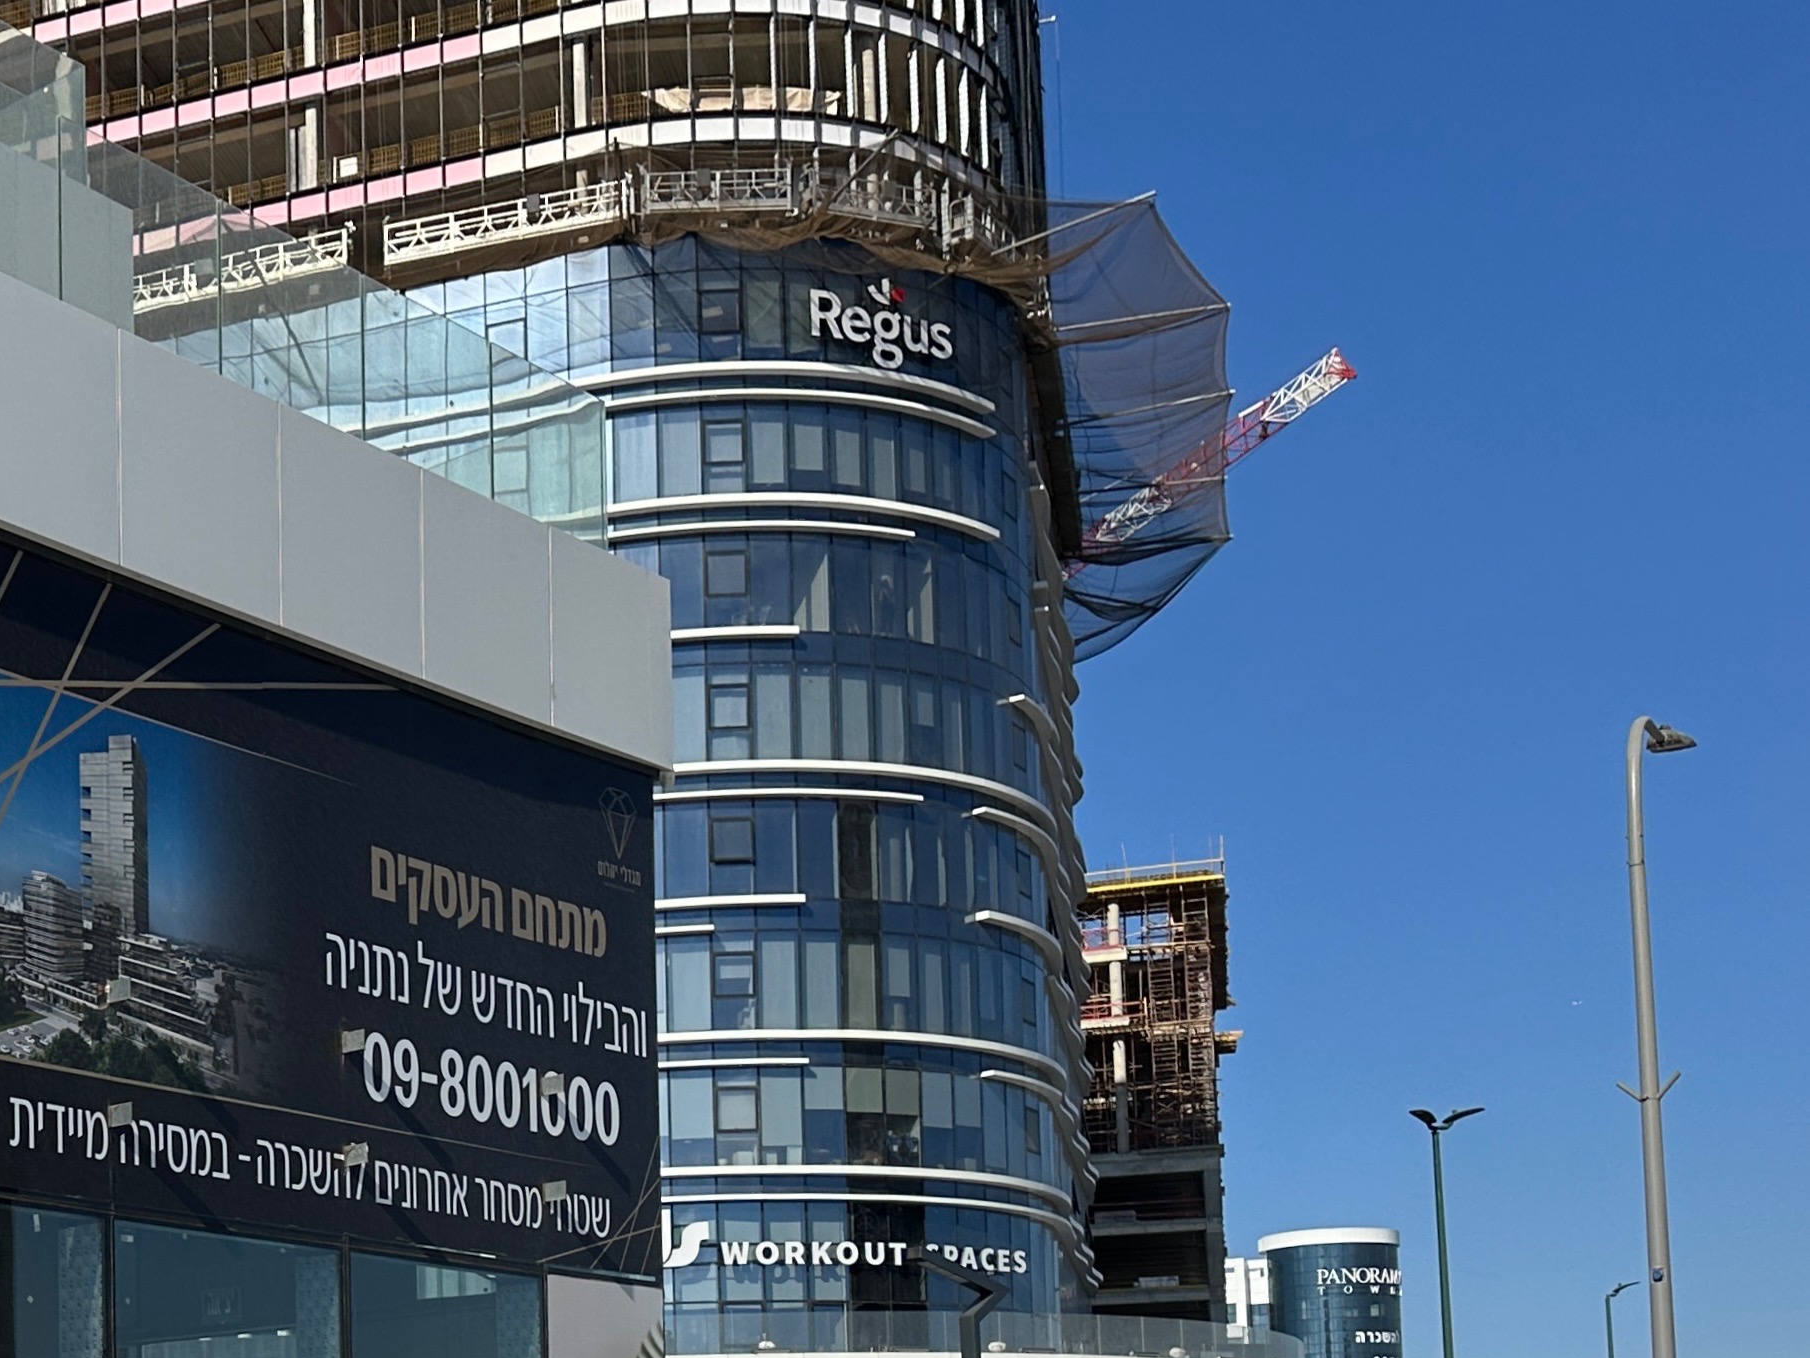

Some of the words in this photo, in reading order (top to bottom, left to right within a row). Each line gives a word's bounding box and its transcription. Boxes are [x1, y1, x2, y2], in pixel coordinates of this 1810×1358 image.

[809, 288, 953, 369] Regus
[371, 845, 504, 932] העסקים
[511, 887, 607, 958] מתחם
[325, 932, 410, 1005] נתניה
[417, 940, 461, 1016] של
[471, 969, 555, 1039] החדש
[563, 981, 648, 1058] והבילוי
[363, 1031, 621, 1146] 09-8001000
[9, 1096, 109, 1160] מיידית
[120, 1119, 231, 1180] במסירה
[374, 1160, 469, 1218] אחרונים
[475, 1177, 542, 1229] מסחר
[720, 1241, 907, 1267] WORKOUT
